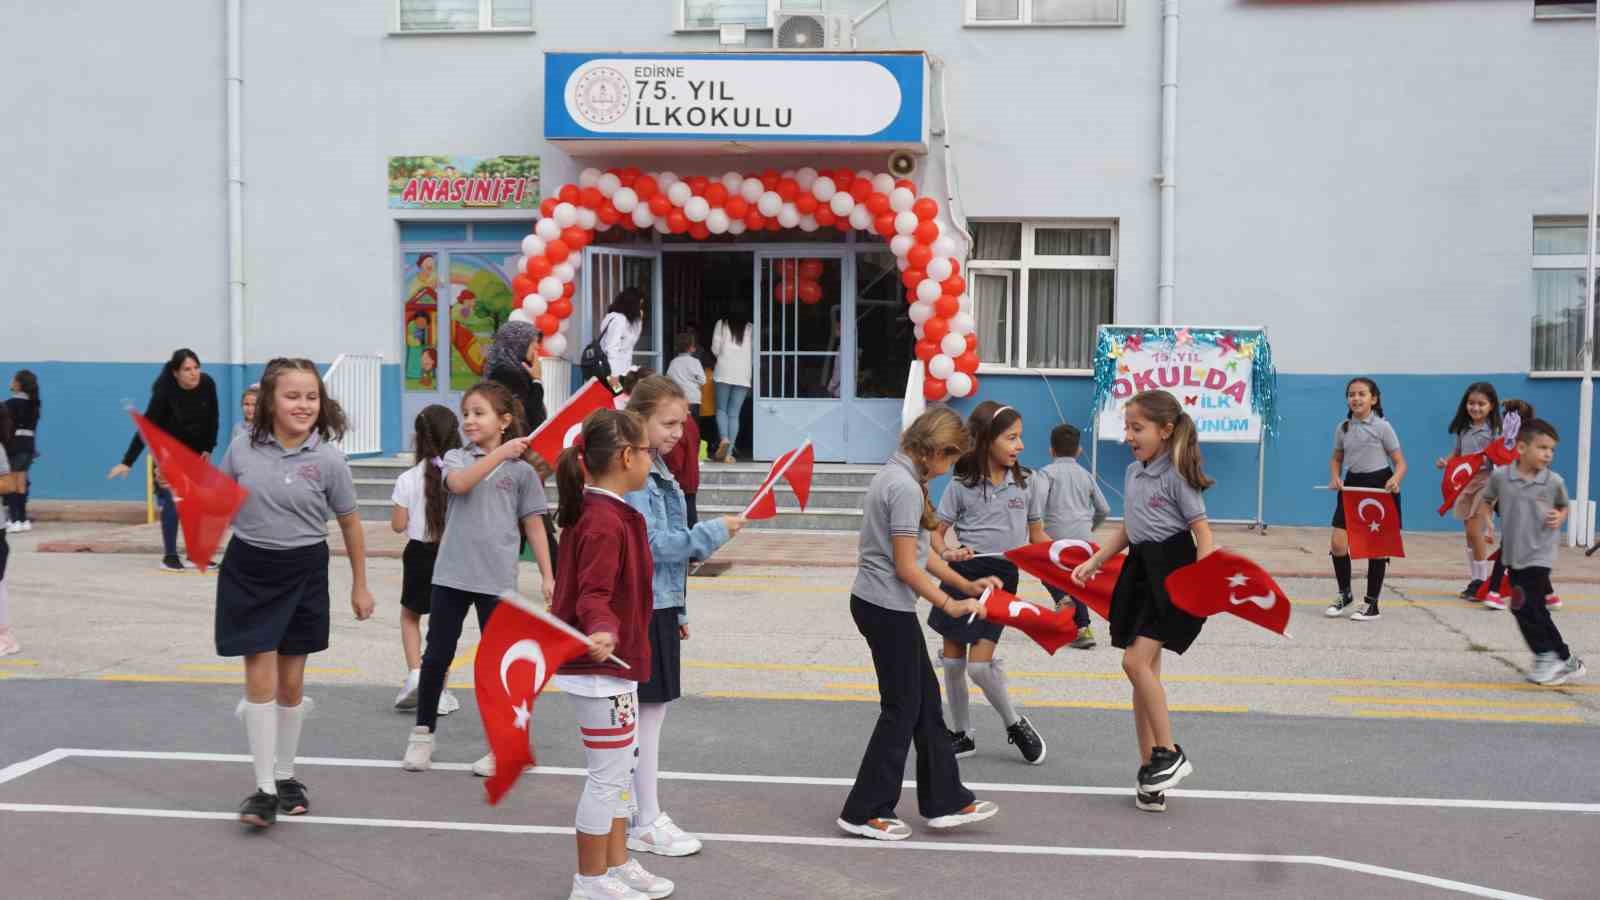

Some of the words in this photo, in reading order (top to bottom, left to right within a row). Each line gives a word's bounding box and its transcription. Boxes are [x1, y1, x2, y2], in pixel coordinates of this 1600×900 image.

[634, 66, 685, 78] EDİRNE
[635, 81, 676, 101] 75.
[689, 81, 734, 101] YIL
[635, 102, 793, 127] İLKOKULU
[402, 177, 527, 203] ANASINIFI
[1111, 366, 1247, 405] OKULDA
[1201, 393, 1231, 409] İLK
[1196, 416, 1249, 432] ÜNÜM
